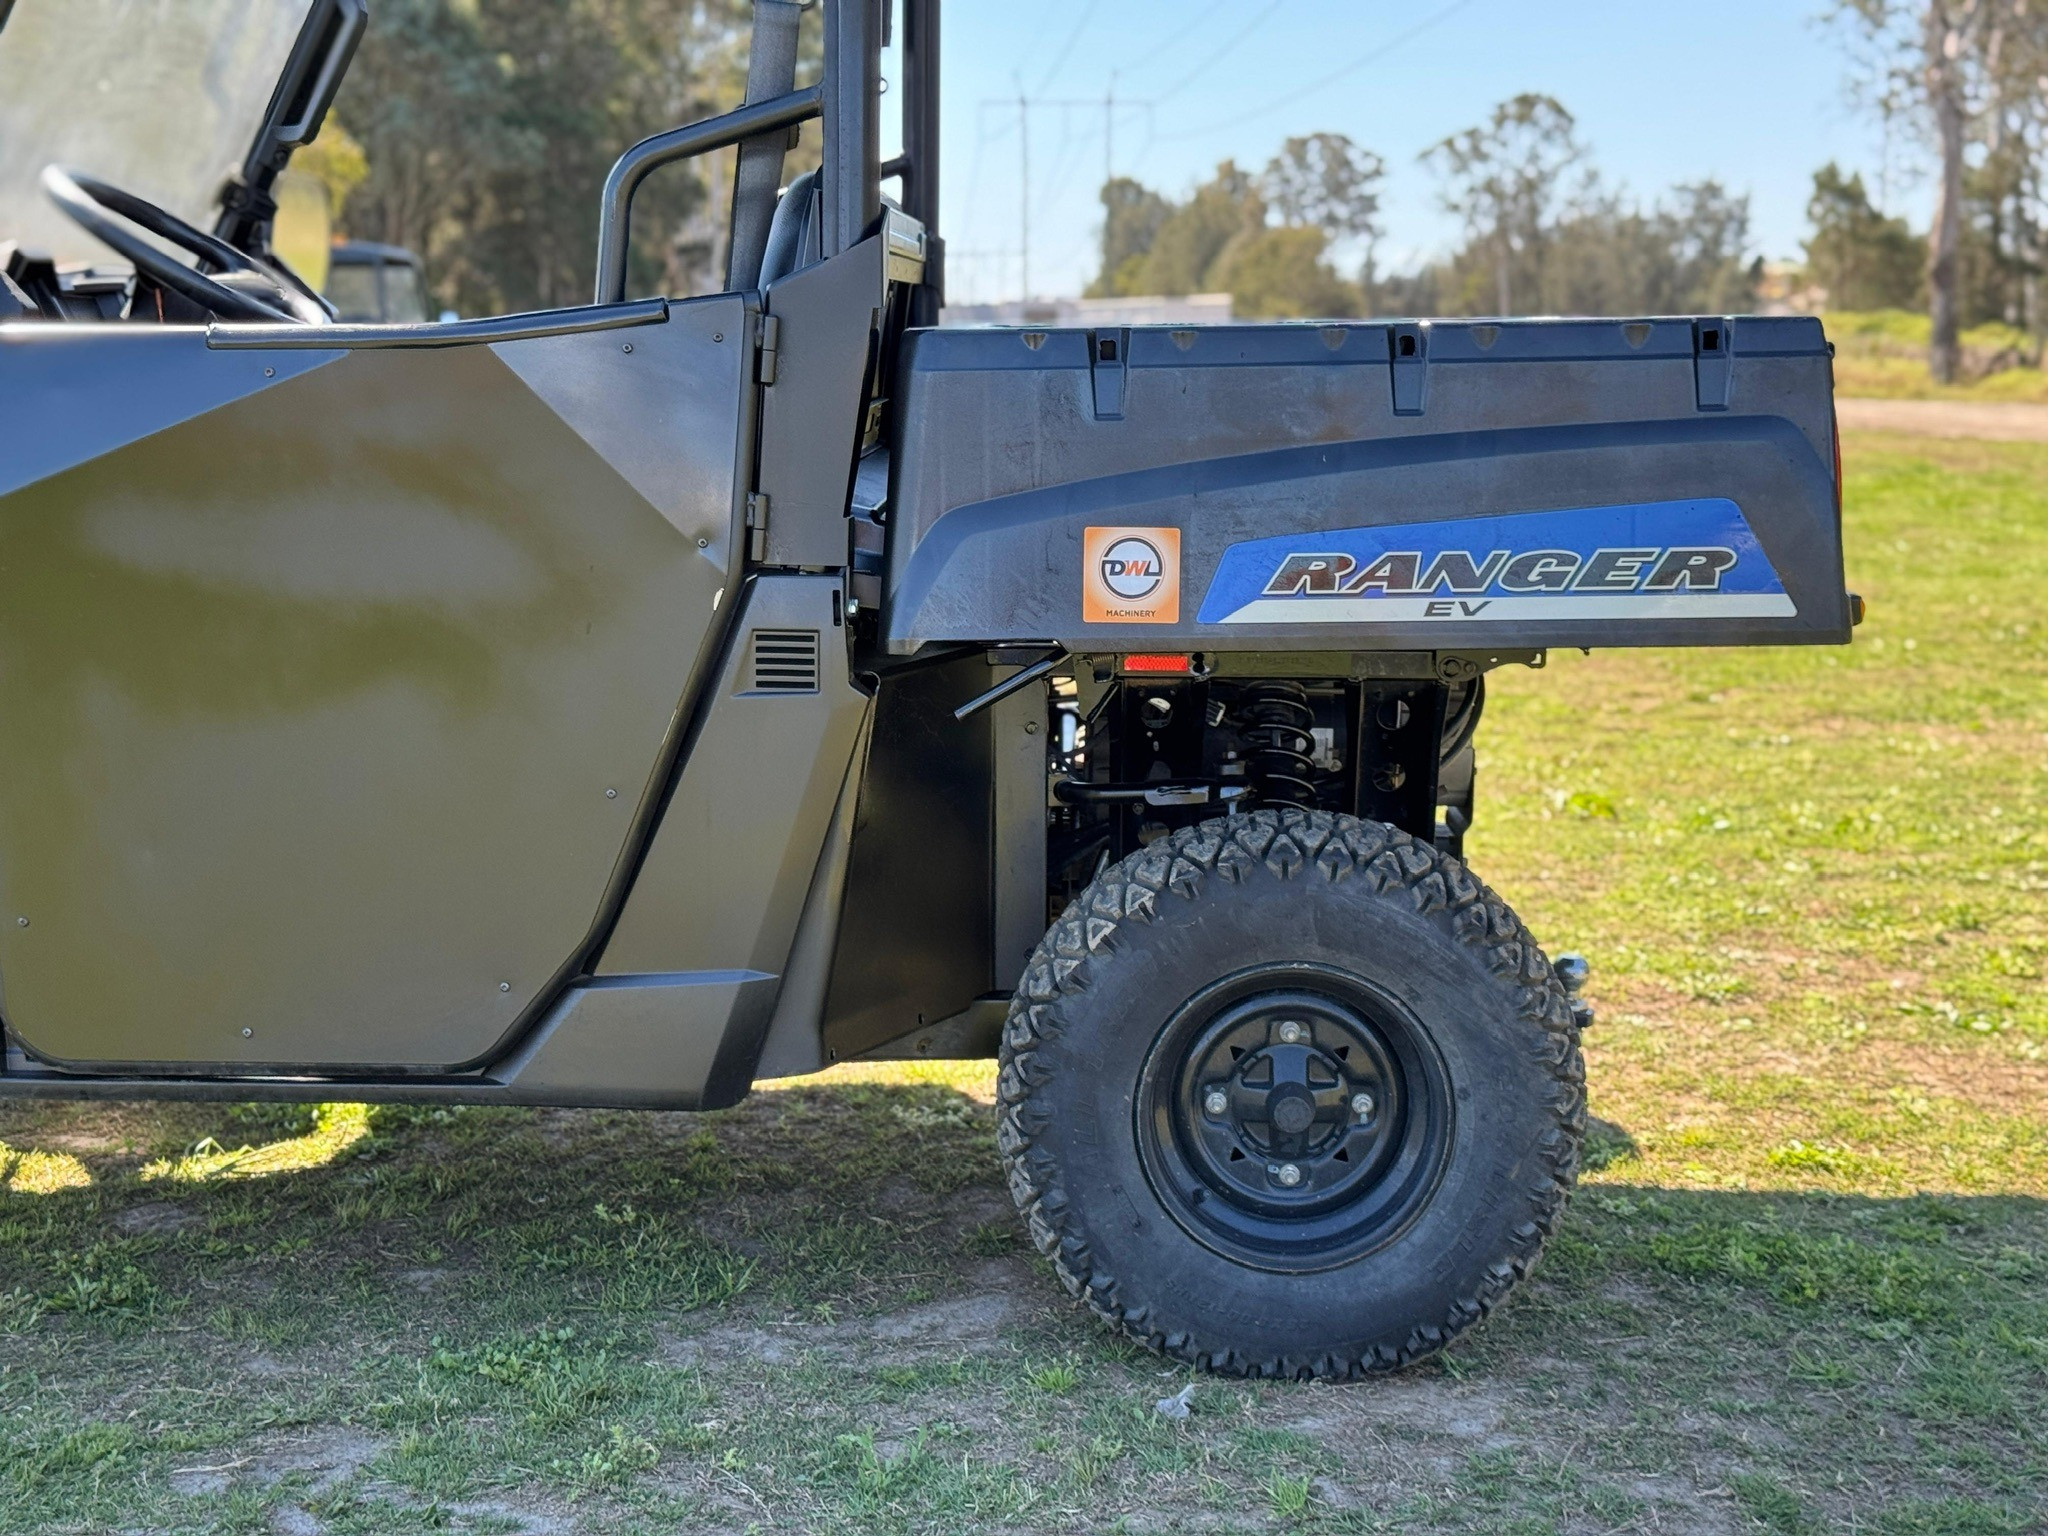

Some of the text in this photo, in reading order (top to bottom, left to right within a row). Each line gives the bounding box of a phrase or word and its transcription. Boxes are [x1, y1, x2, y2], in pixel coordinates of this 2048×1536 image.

[1104, 559, 1161, 576] DWL
[1261, 547, 1738, 595] RANGER
[1105, 609, 1156, 618] MACHINERY
[1424, 600, 1493, 617] EV
